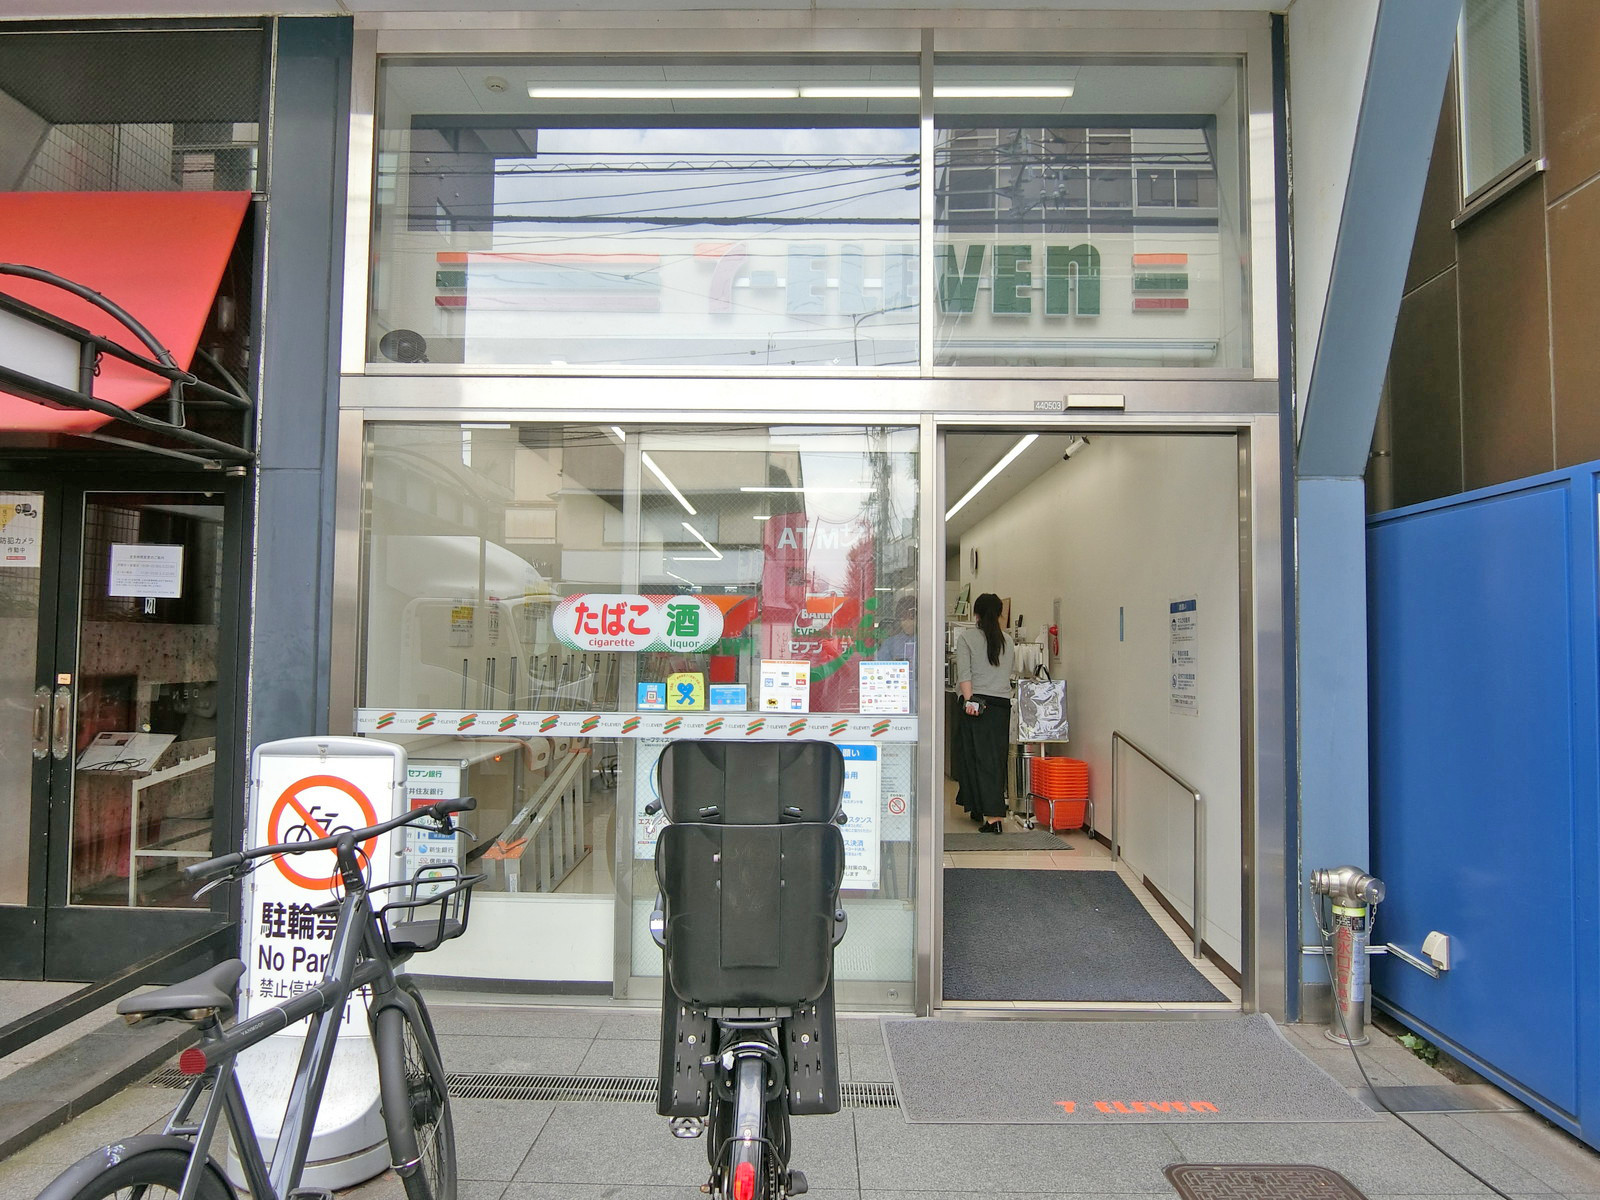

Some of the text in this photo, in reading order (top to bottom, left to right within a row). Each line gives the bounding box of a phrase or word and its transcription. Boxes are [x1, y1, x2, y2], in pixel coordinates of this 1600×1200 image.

[1034, 401, 1061, 411] 440503
[573, 601, 701, 637] たばこ 酒
[588, 637, 701, 649] cigarette liquor
[257, 944, 329, 973] No Par
